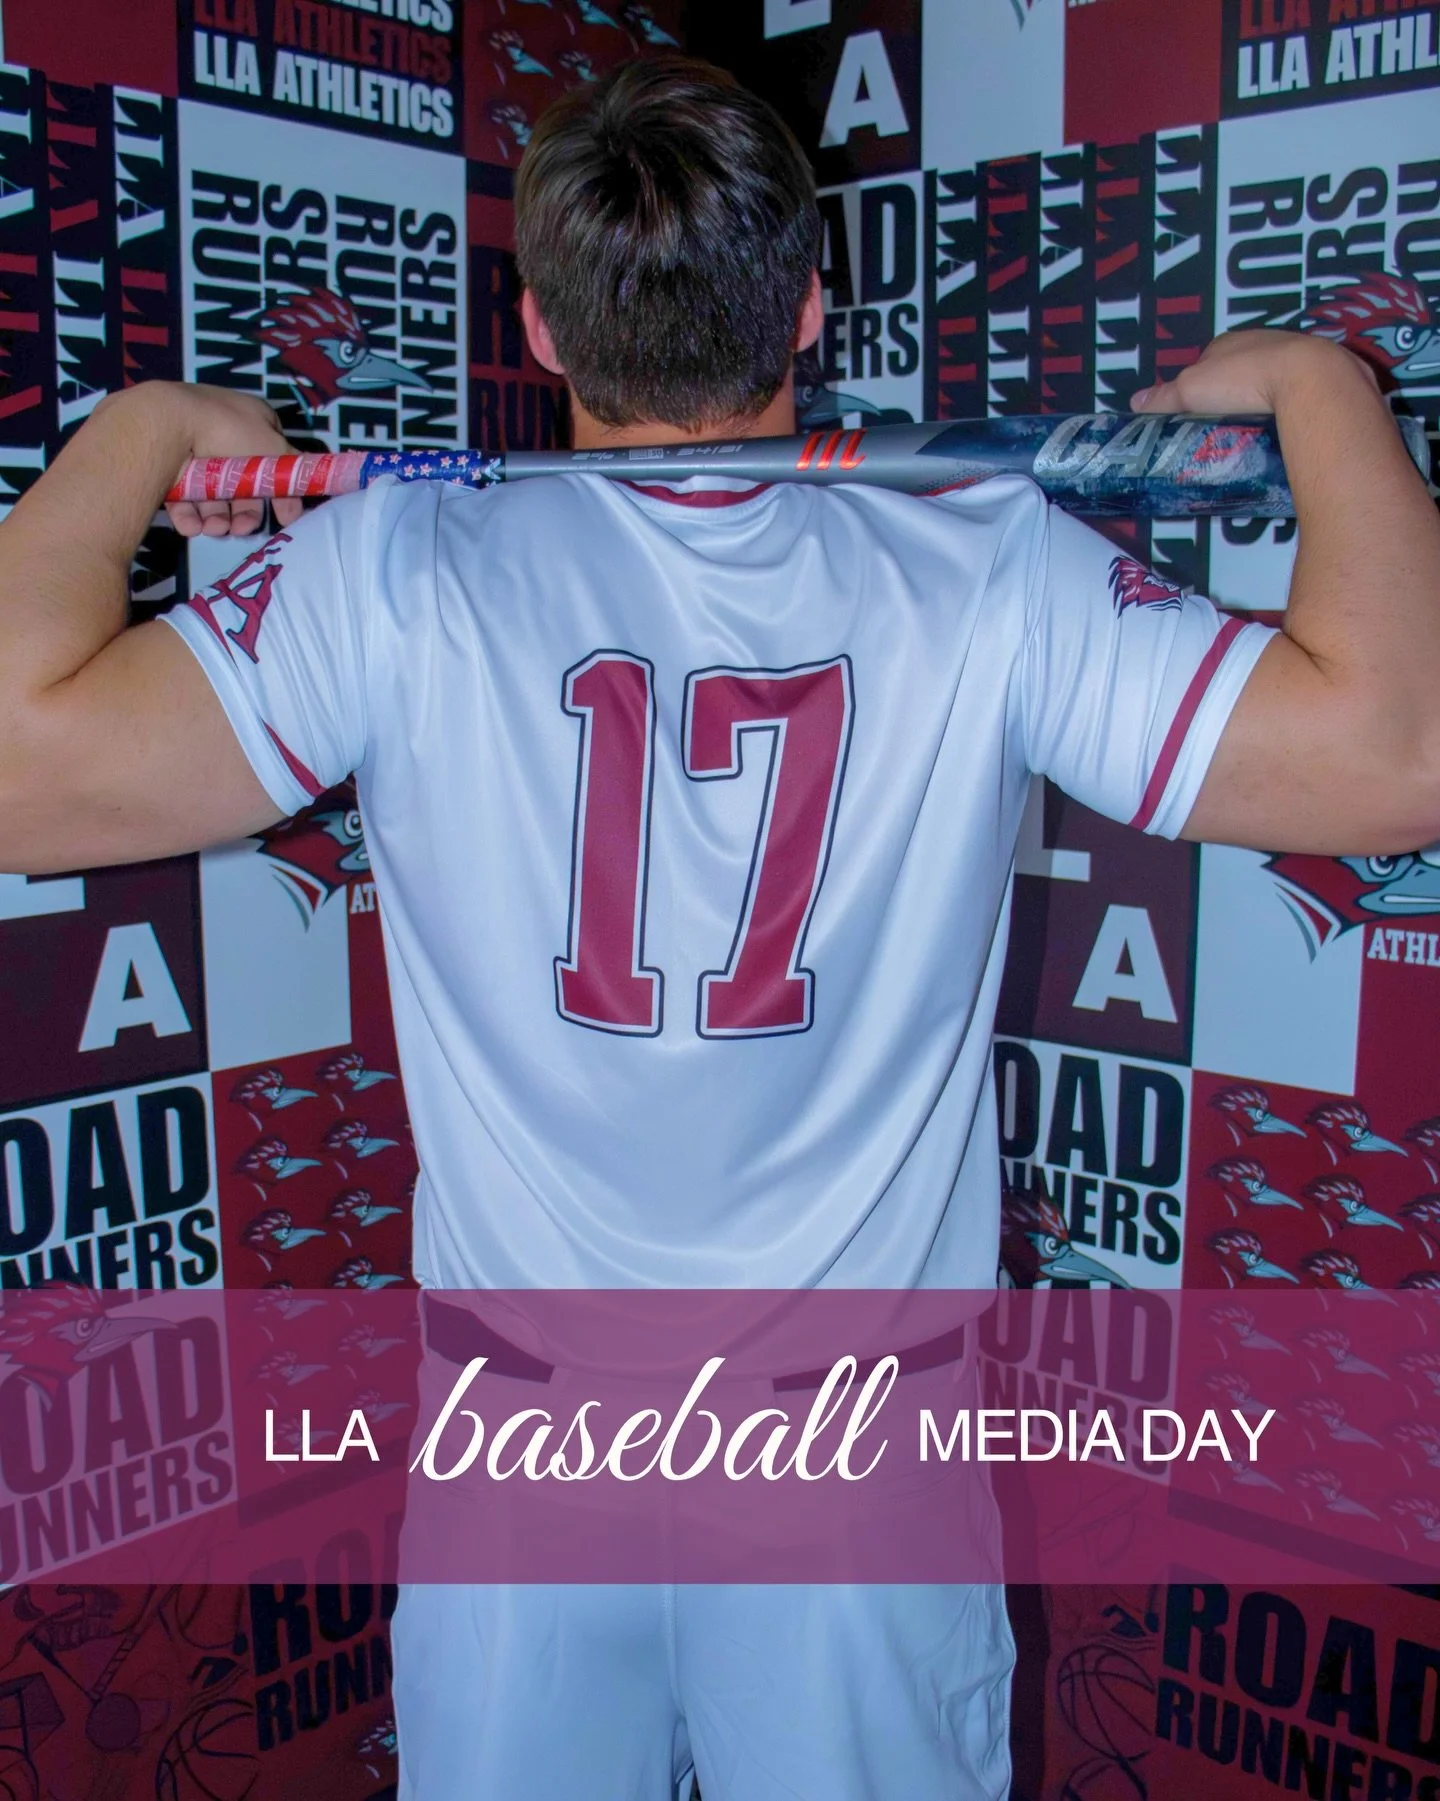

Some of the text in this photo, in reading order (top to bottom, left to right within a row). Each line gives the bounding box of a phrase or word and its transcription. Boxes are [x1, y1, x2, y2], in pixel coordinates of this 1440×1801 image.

[194, 30, 454, 138] LLA ATHLETICS
[1237, 35, 1311, 99] LLA
[399, 208, 458, 452] NNERS
[553, 648, 856, 1040] 17
